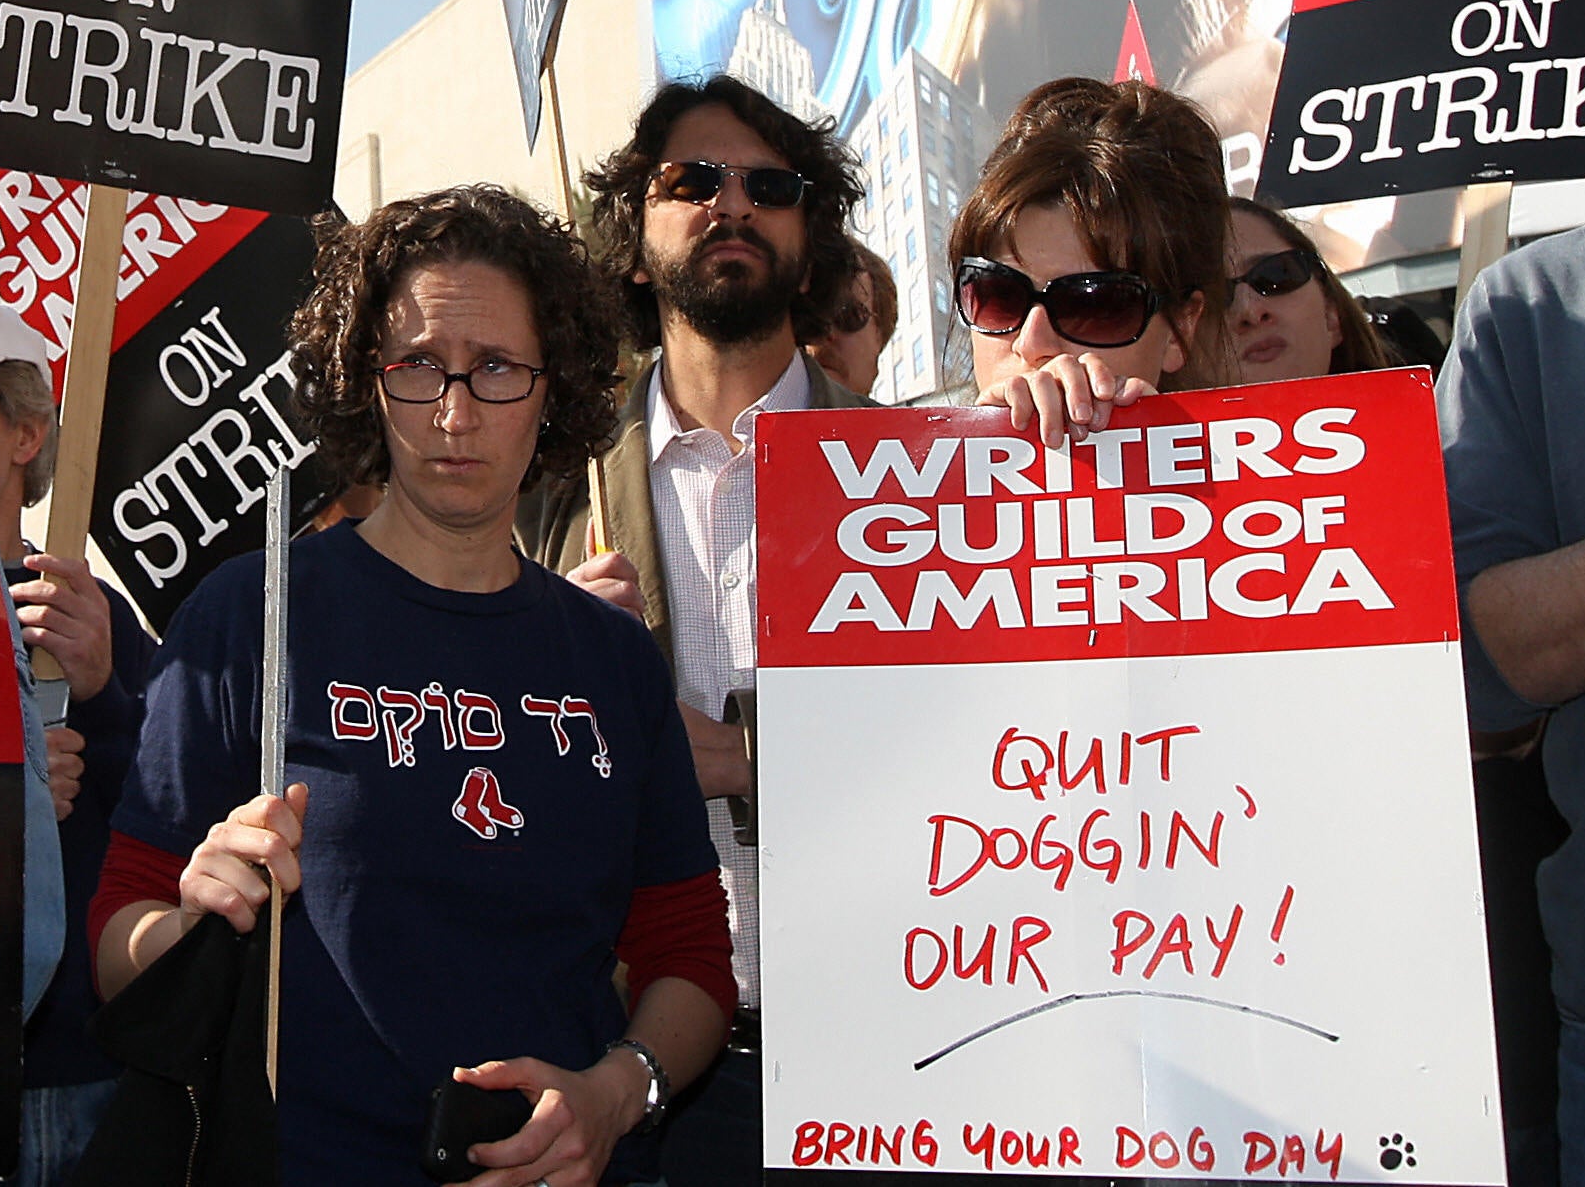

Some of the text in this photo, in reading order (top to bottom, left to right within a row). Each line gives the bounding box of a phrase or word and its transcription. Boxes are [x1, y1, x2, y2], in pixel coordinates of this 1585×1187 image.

[158, 305, 248, 407] ON
[818, 407, 1368, 500] WRITERS
[835, 492, 1346, 568] GUILD OF
[806, 546, 1396, 634] AMERICA
[991, 724, 1201, 802] QUIT
[926, 784, 1260, 897] DOGGIN'
[903, 884, 1296, 994] OUR PAY!
[791, 1118, 1345, 1180] BRING YOUR DOG DAY
